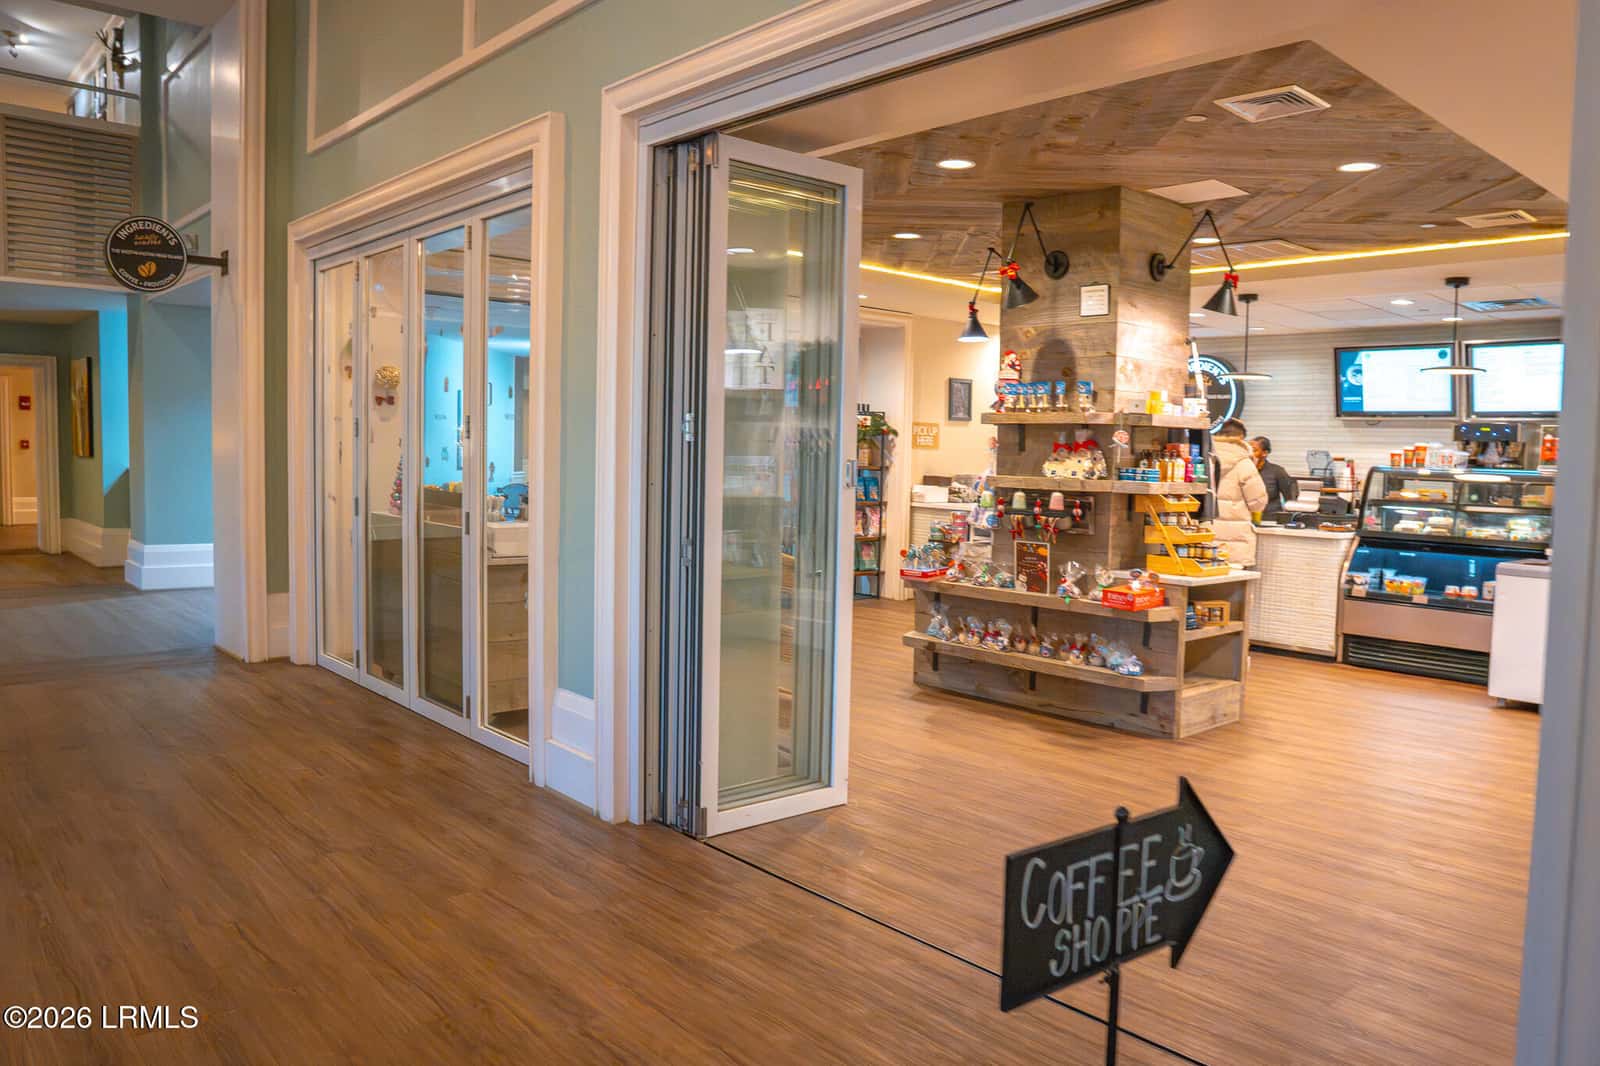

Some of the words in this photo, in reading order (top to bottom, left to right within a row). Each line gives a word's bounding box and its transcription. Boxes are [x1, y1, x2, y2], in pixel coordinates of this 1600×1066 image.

[116, 221, 178, 246] INGREDIENTS
[1020, 834, 1164, 929] COFFEE
[1049, 895, 1164, 977] SHOPPE
